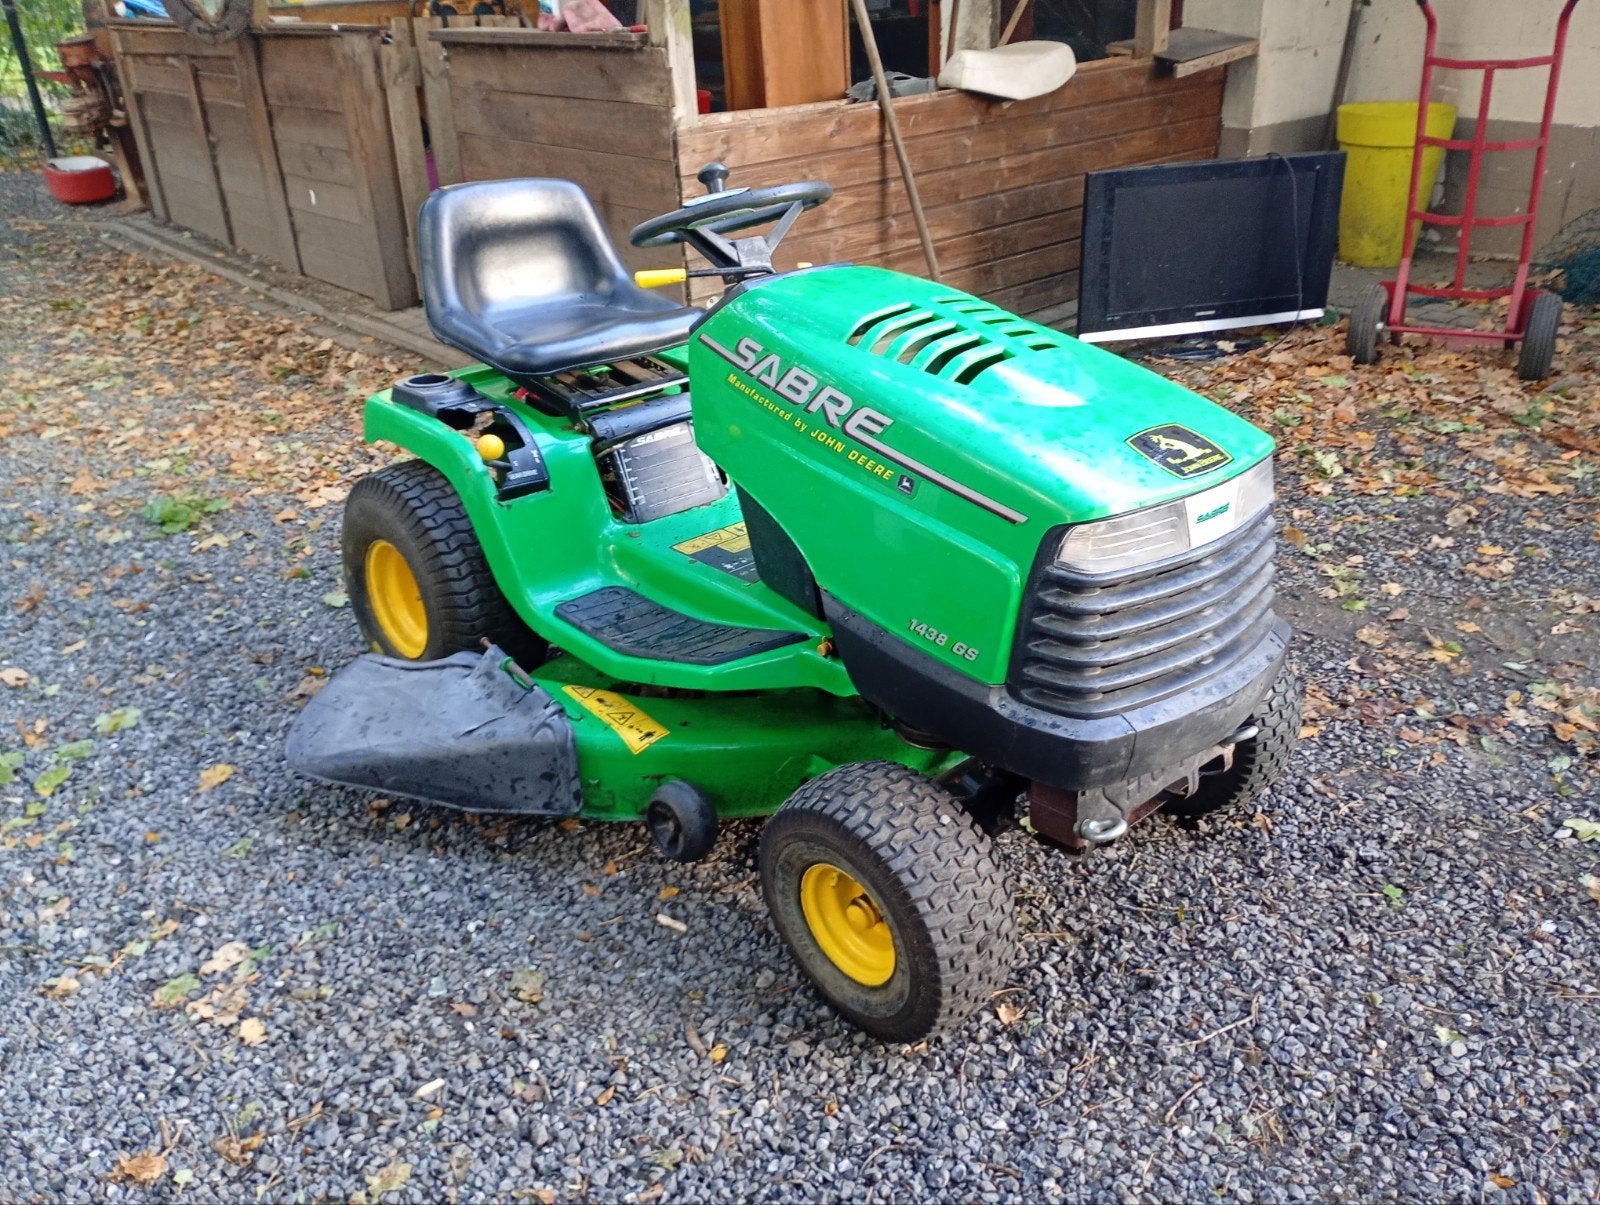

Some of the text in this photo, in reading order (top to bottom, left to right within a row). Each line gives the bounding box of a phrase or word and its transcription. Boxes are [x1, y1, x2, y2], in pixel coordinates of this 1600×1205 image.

[728, 373, 895, 480] Manufactured by JOHN DEERE
[735, 337, 894, 440] SABRE
[909, 618, 979, 661] 1438 GS
